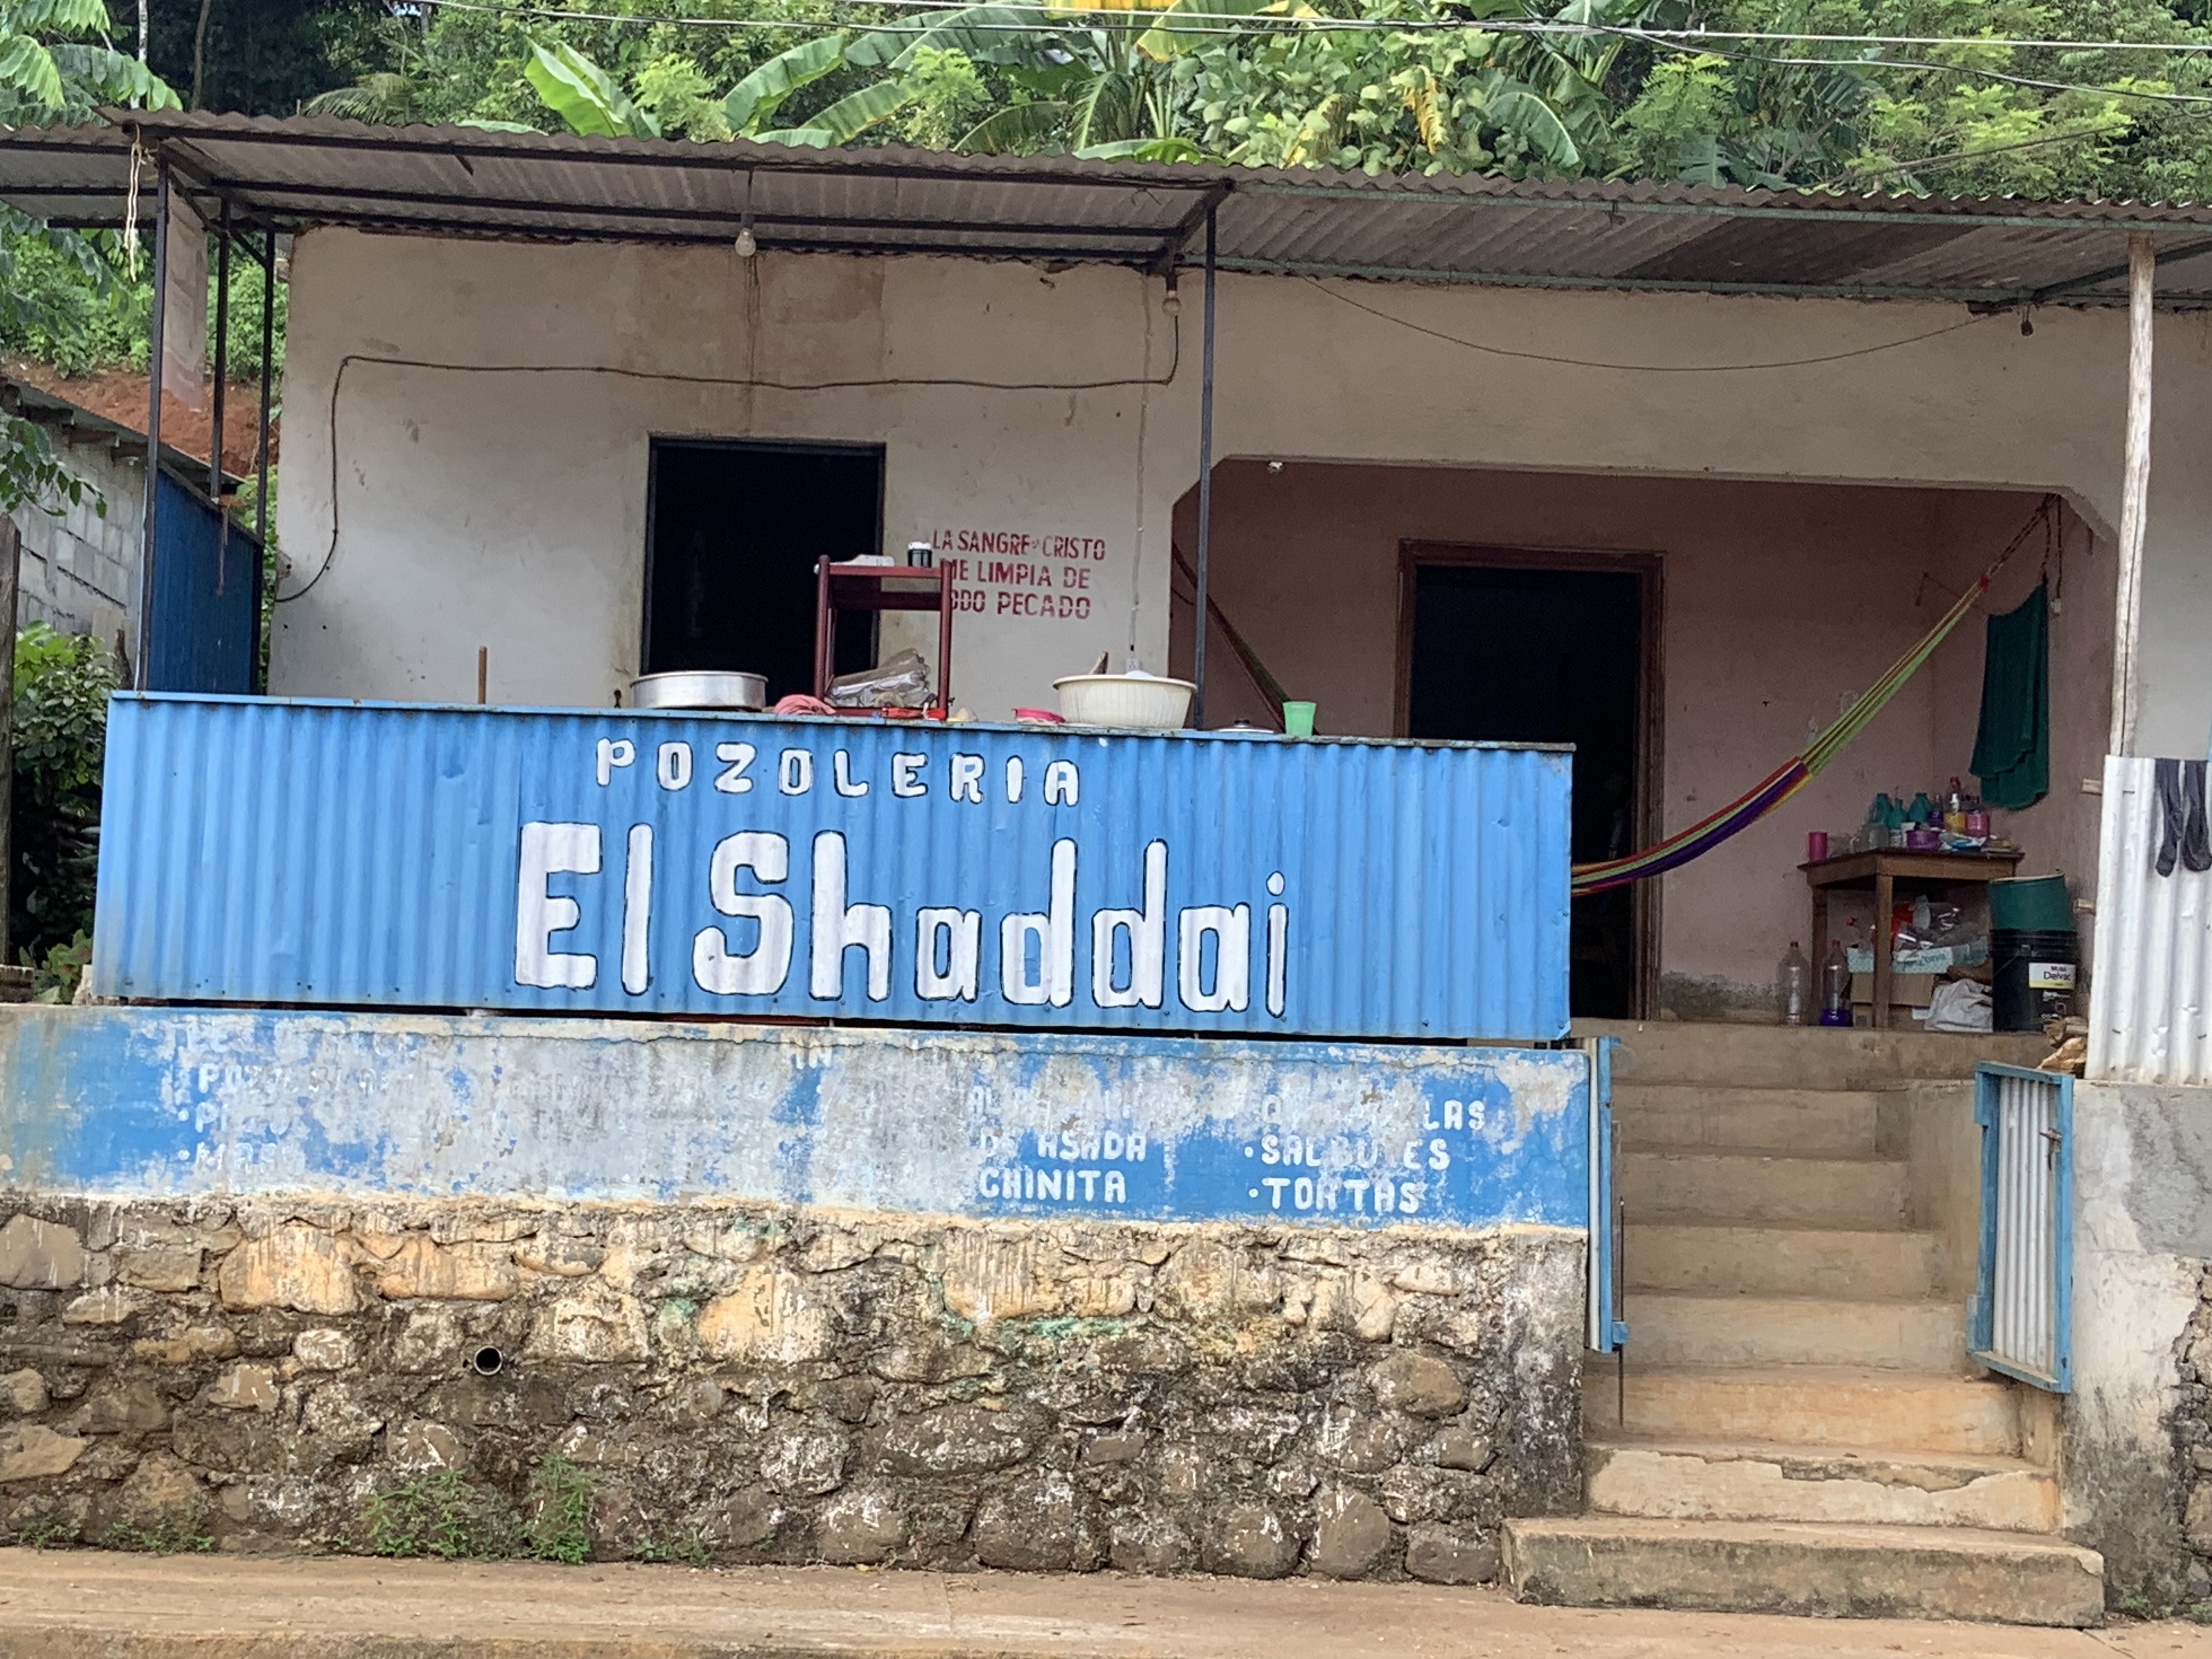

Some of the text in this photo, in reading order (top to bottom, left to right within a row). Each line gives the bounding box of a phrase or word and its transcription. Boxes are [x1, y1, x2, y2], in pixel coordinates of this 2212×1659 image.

[933, 529, 952, 550] LA
[958, 530, 1030, 556] SANGRE
[1042, 535, 1105, 561] CRISTO
[978, 561, 1052, 587] LIMPIA
[1063, 567, 1091, 589] DE
[950, 589, 1091, 619] ODO PECADO
[596, 737, 1080, 806] POZOLERIA
[515, 821, 1289, 1018] El Shaddai
[1037, 1129, 1147, 1162] ASADA
[1261, 1133, 1451, 1171] SALBUES
[979, 1166, 1127, 1204] CHINITA
[1261, 1176, 1420, 1214] TORTAS
